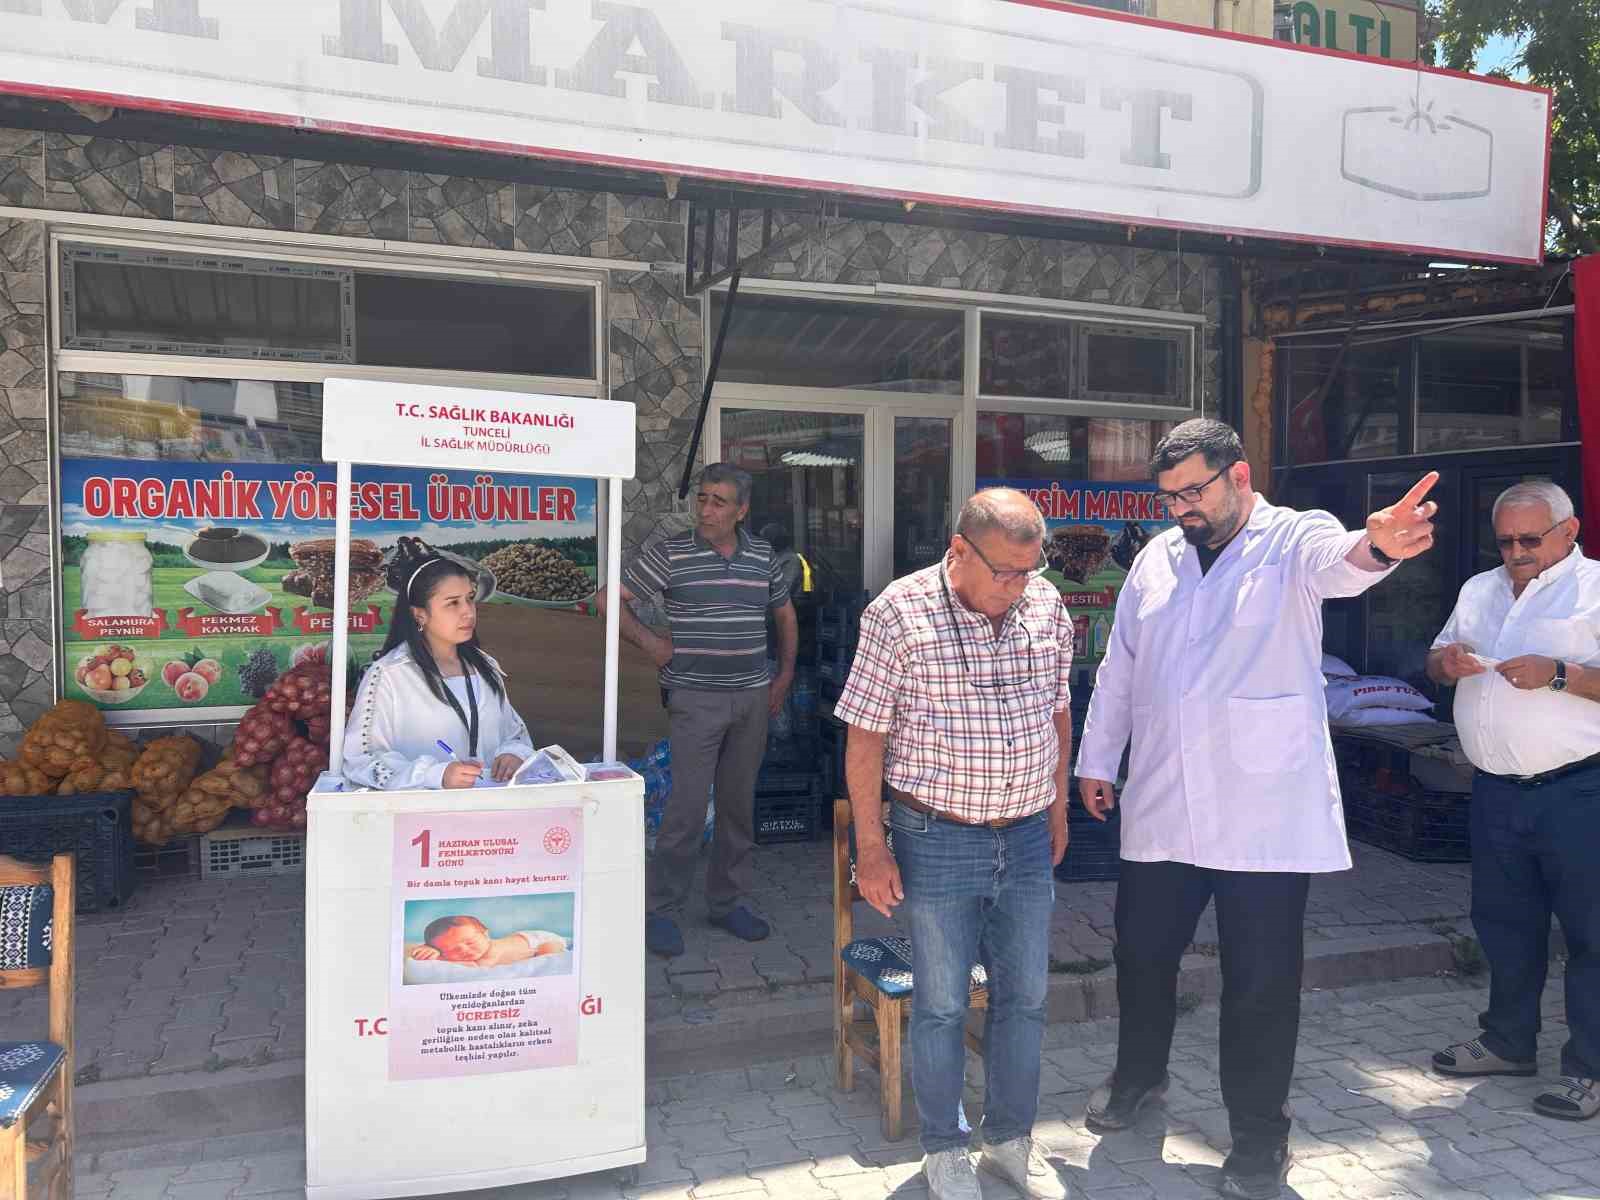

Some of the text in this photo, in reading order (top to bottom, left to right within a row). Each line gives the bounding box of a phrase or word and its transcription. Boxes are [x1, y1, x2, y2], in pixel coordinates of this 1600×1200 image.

[322, 0, 1192, 170] MARKET
[395, 403, 575, 429] T.C. SAĞLIK BAKANLIĞI
[463, 425, 511, 439] TUNCELİ
[420, 435, 551, 455] İL SAĞLIK MÜDÜRLÜĞÜ
[83, 470, 577, 522] ORGANİK YÖRESEL ÜRÜNLER
[87, 617, 156, 628] SALAMURA
[202, 616, 257, 625] PEKMEZ
[100, 627, 145, 637] PEYNİR
[202, 624, 261, 635] KAYMAK
[411, 829, 433, 868] 1
[456, 1008, 521, 1022] ÜCRETSİZ
